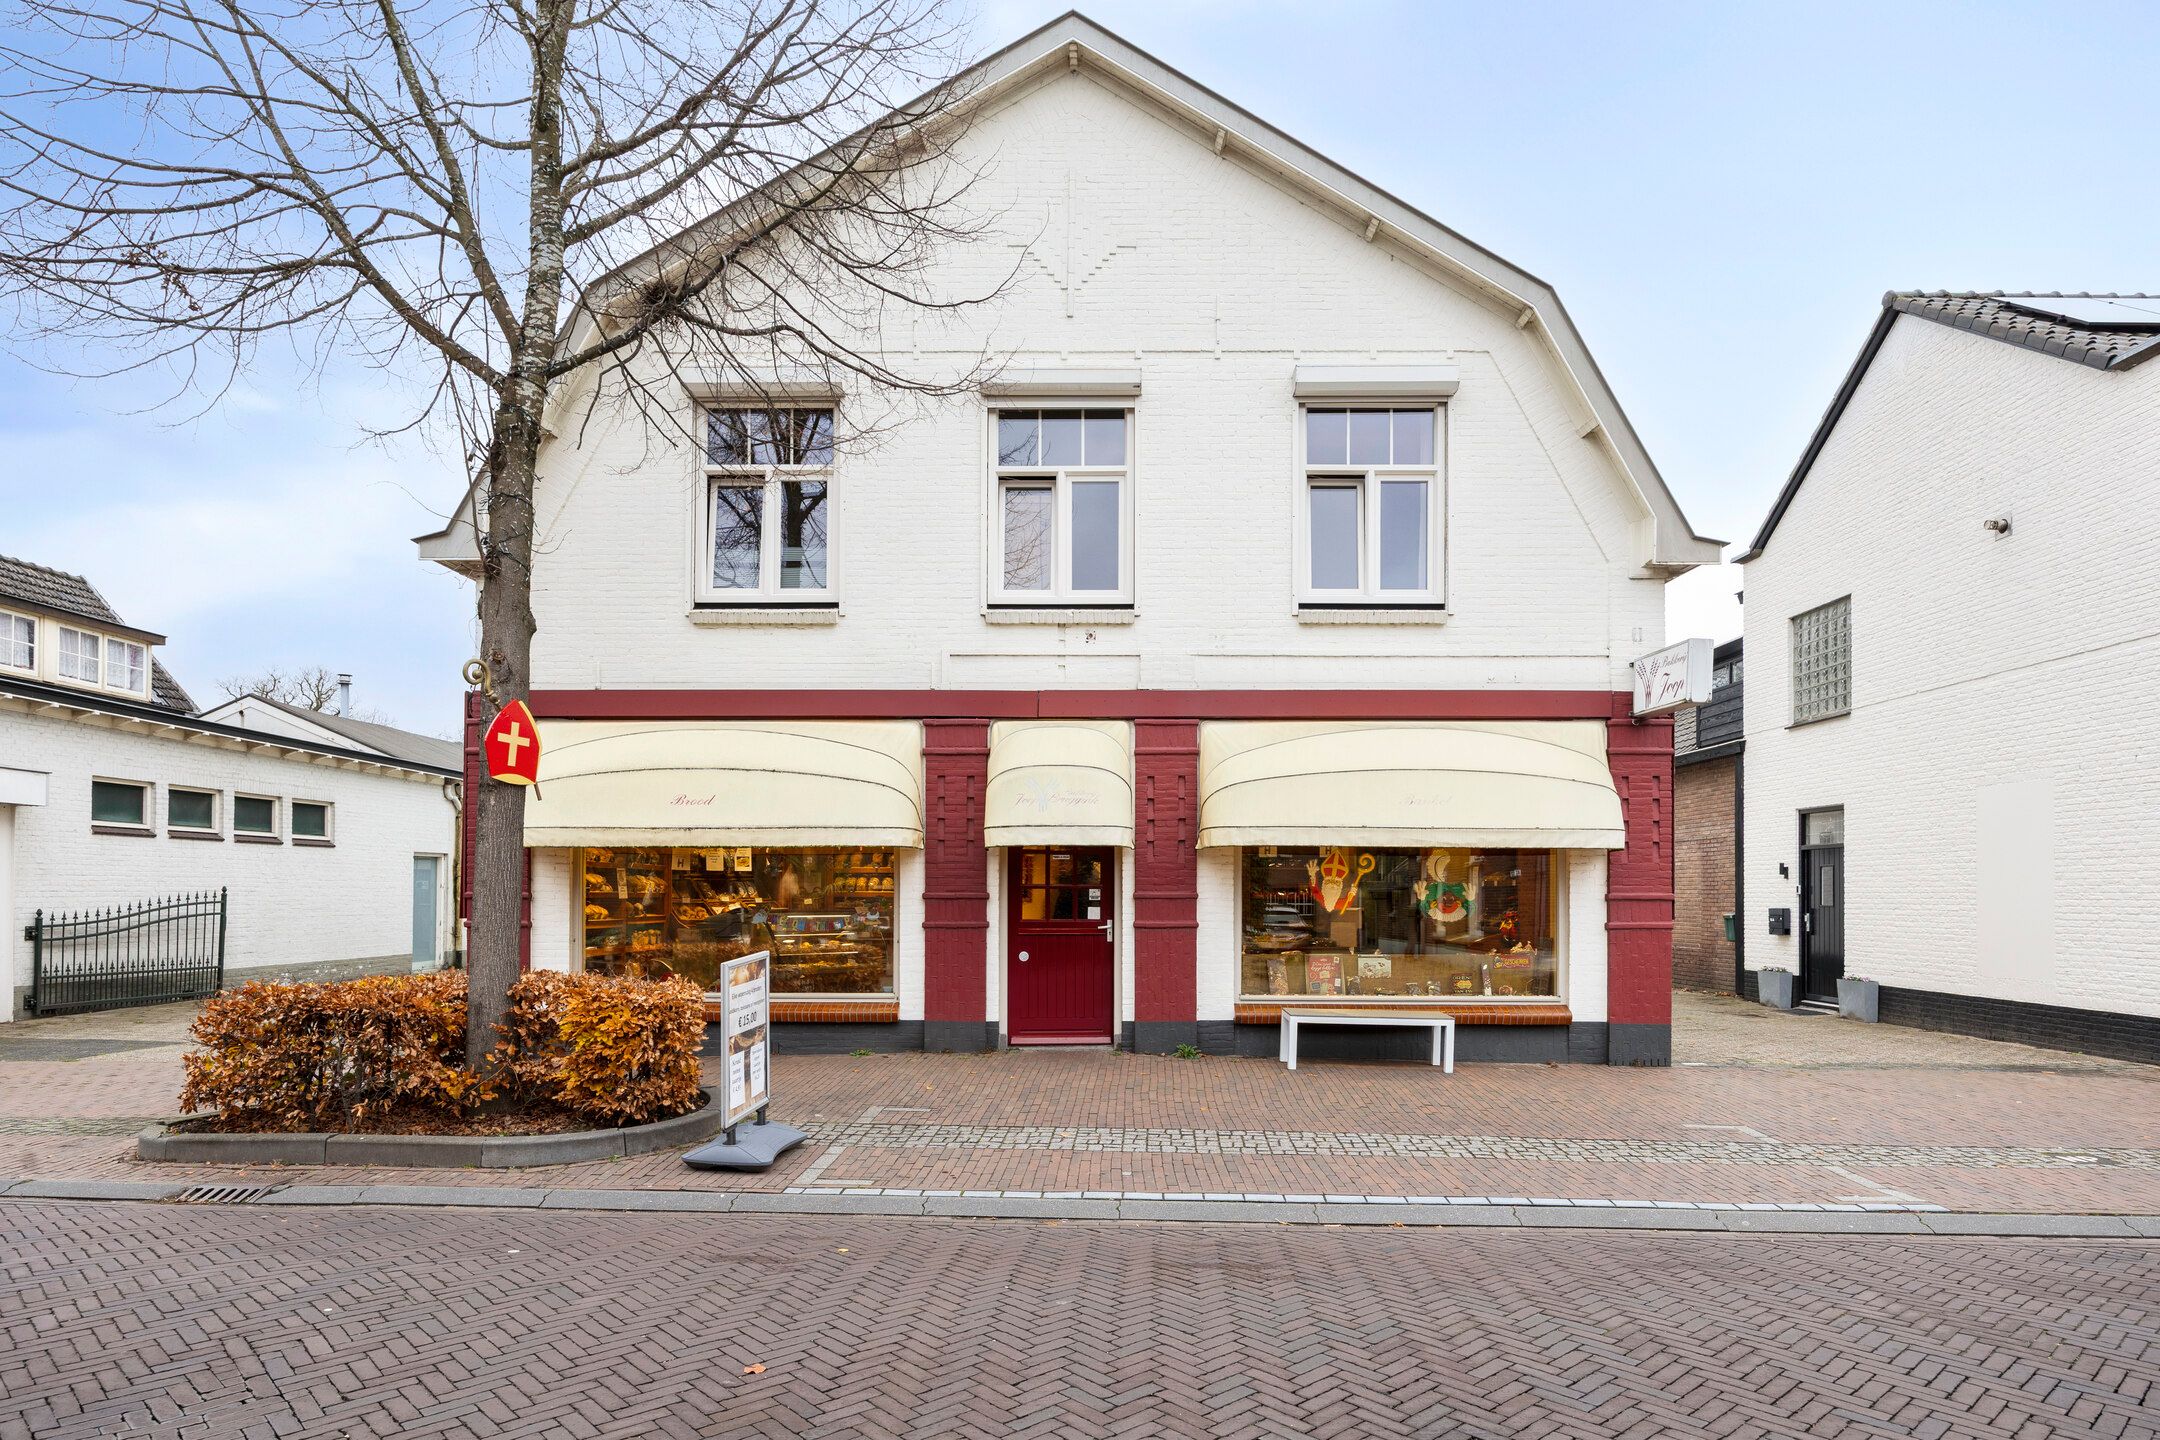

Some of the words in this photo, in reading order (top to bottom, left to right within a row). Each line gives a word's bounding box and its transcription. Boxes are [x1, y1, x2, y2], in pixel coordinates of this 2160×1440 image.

[1658, 672, 1684, 703] Joop
[670, 794, 716, 806] Brood
[743, 1011, 757, 1026] 15,00
